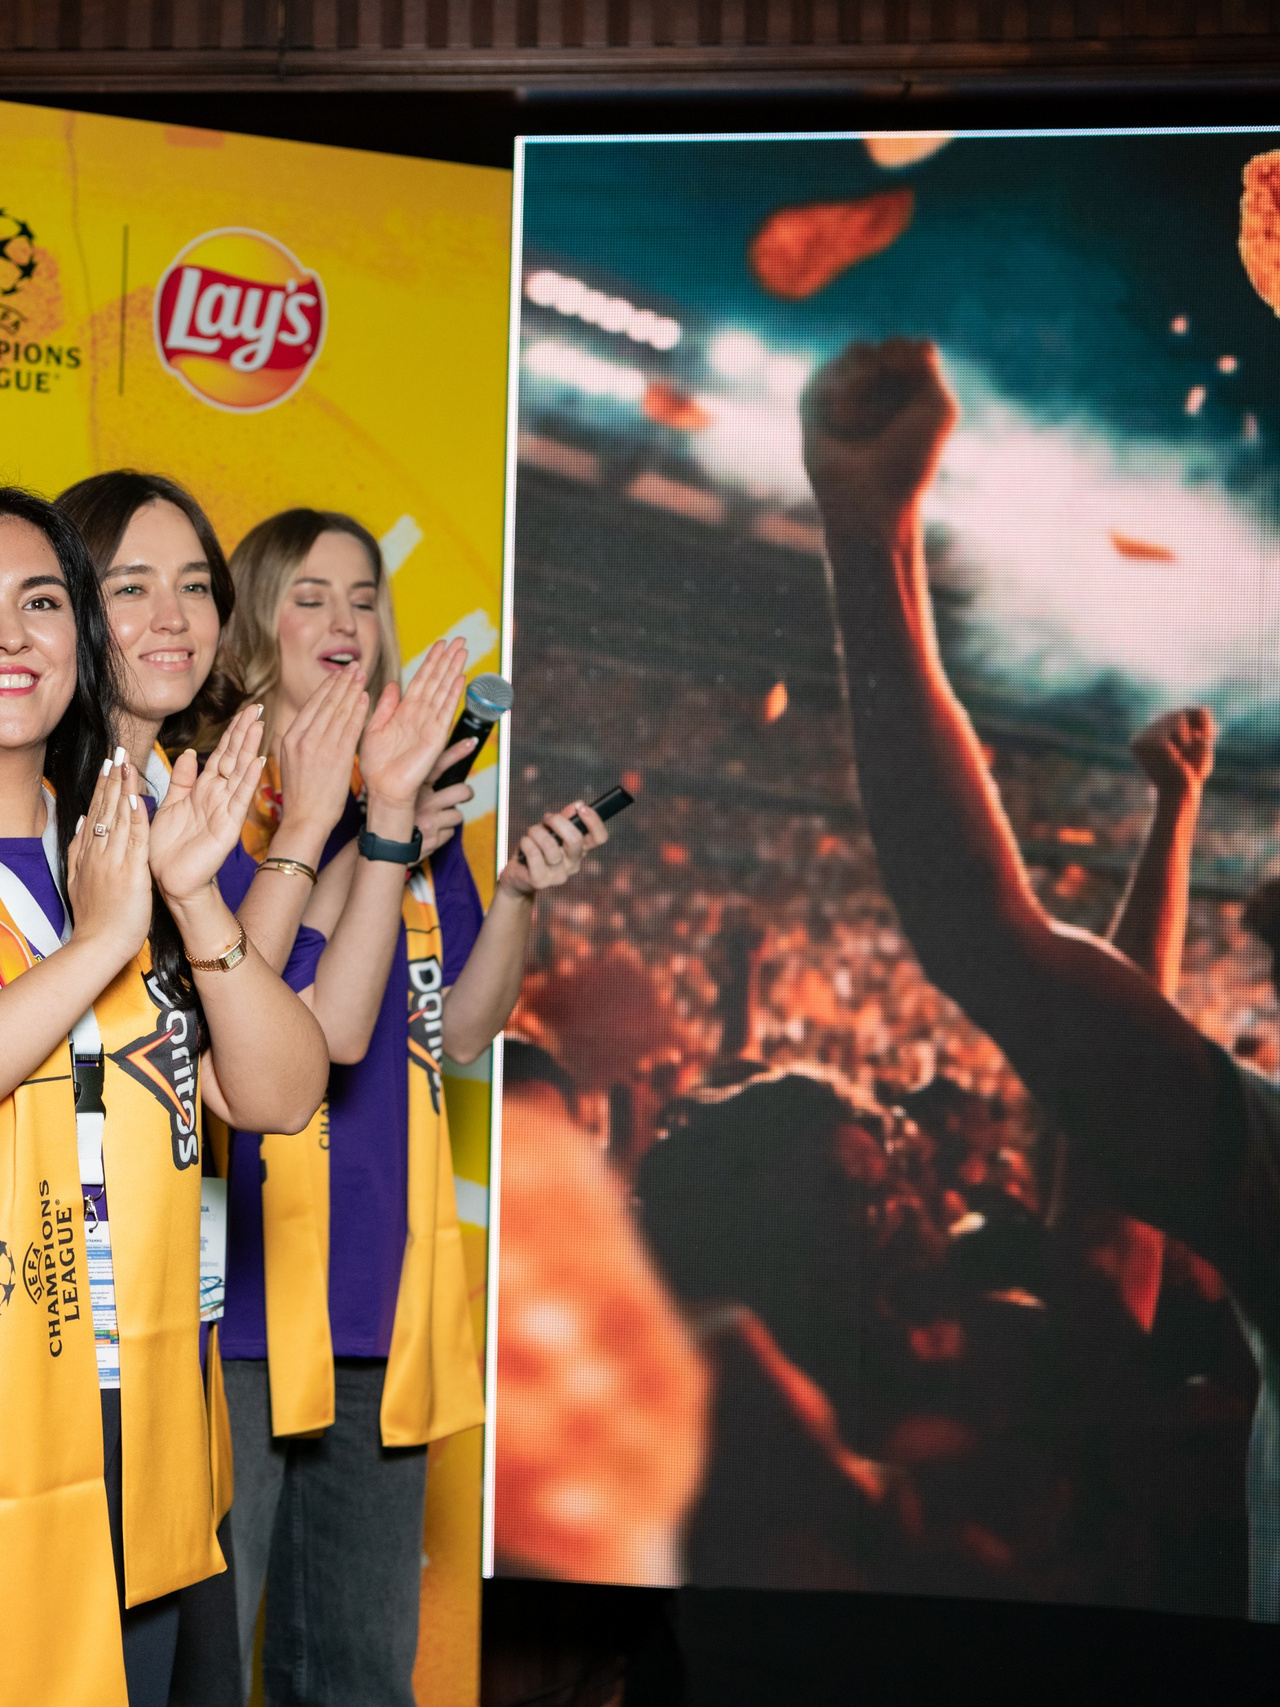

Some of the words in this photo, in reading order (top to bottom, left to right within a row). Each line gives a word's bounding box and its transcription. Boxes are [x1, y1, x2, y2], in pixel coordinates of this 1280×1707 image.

[166, 267, 317, 372] Lay's
[27, 1247, 43, 1301] UEFA
[29, 1179, 63, 1358] CHAMPIONS
